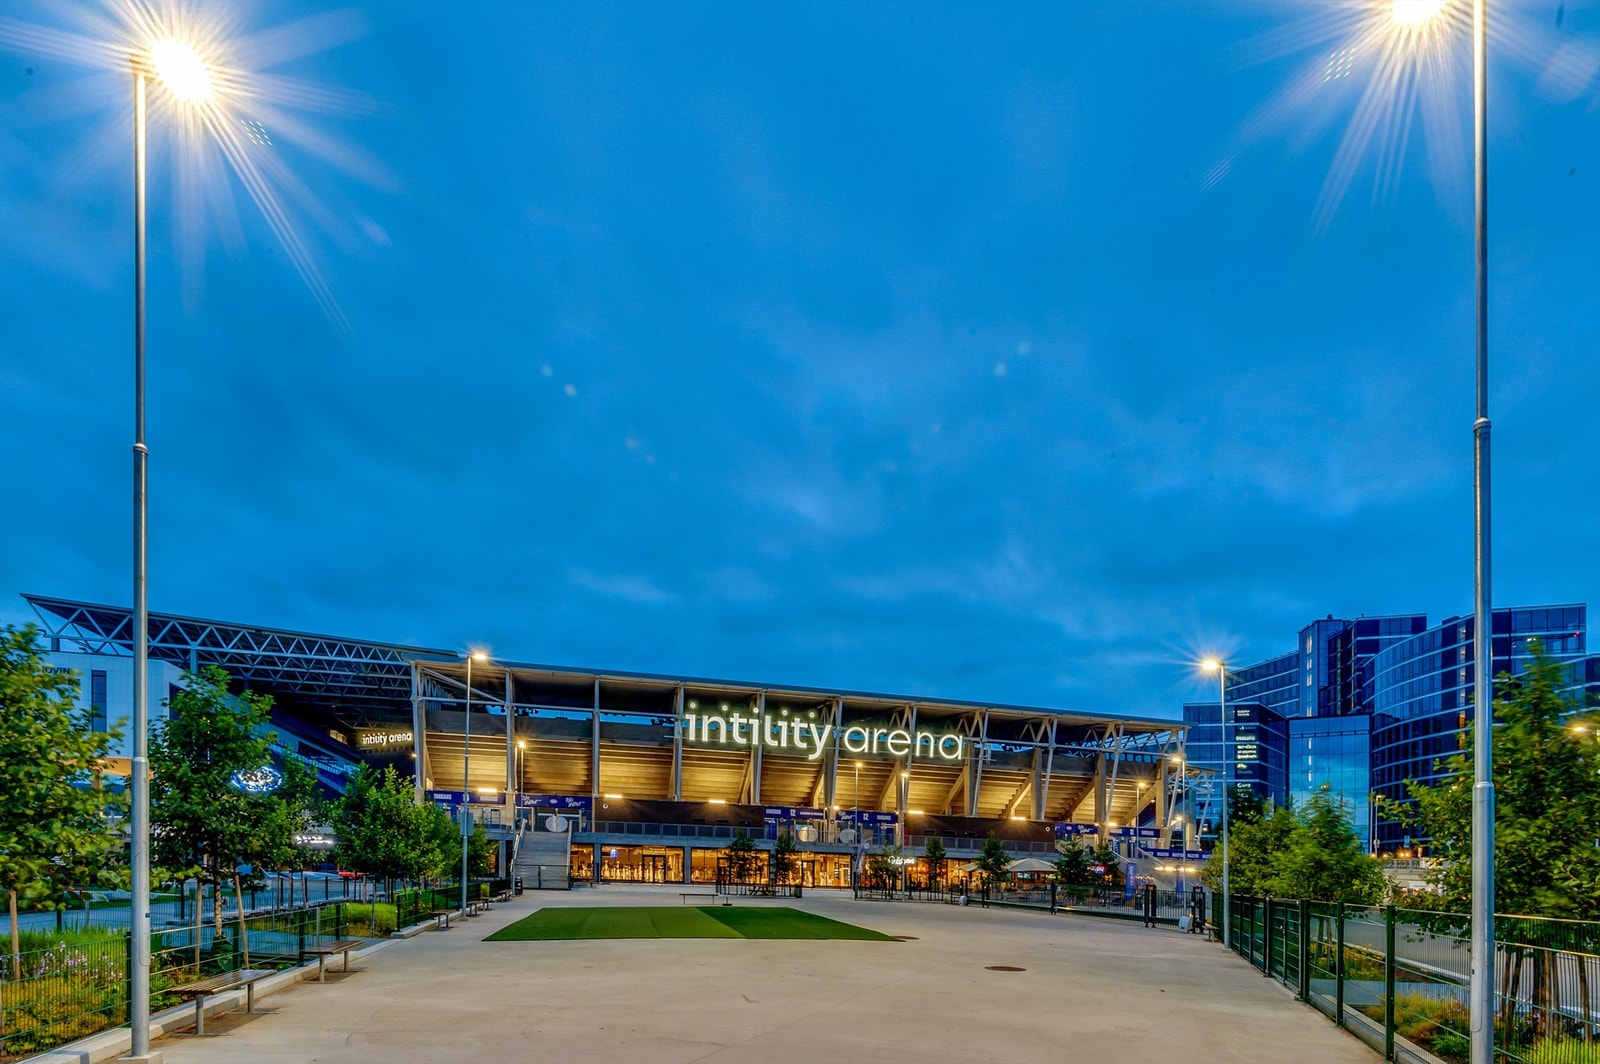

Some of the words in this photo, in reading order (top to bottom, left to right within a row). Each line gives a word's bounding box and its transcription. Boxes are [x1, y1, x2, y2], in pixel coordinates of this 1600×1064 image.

[684, 702, 831, 760] intility
[844, 726, 965, 760] arena
[362, 732, 387, 746] intility
[389, 732, 412, 743] arena
[790, 809, 796, 817] 12
